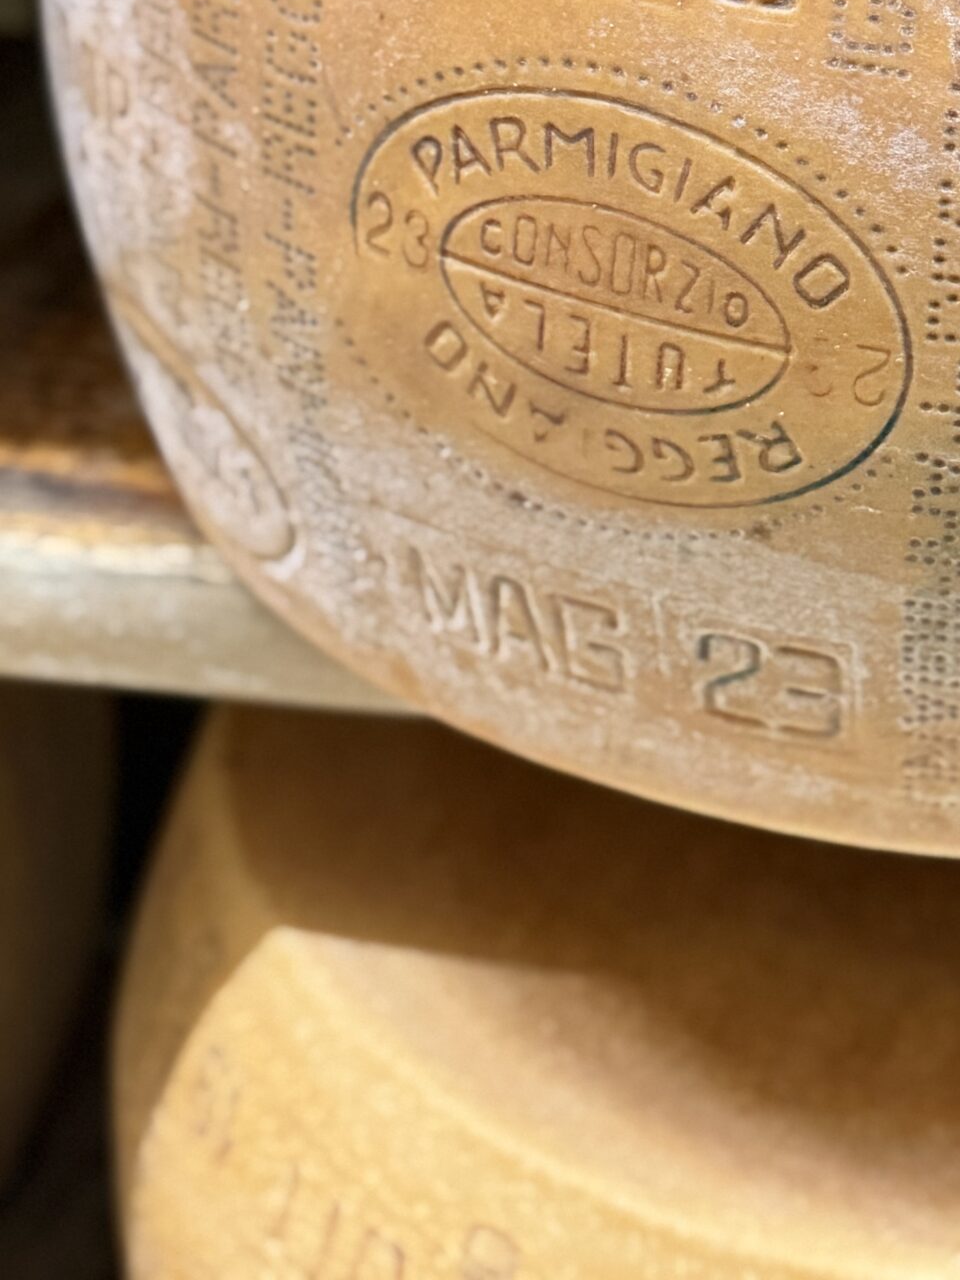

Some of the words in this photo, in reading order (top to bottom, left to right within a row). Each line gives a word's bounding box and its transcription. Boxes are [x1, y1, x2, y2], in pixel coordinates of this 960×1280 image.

[364, 189, 431, 273] 23
[410, 115, 851, 309] PARMIGIANO
[478, 214, 750, 328] CONSORZIO
[423, 318, 803, 484] REGGIANO
[478, 279, 738, 395] TUTELA
[402, 542, 628, 694] MAG
[698, 632, 843, 741] 23
